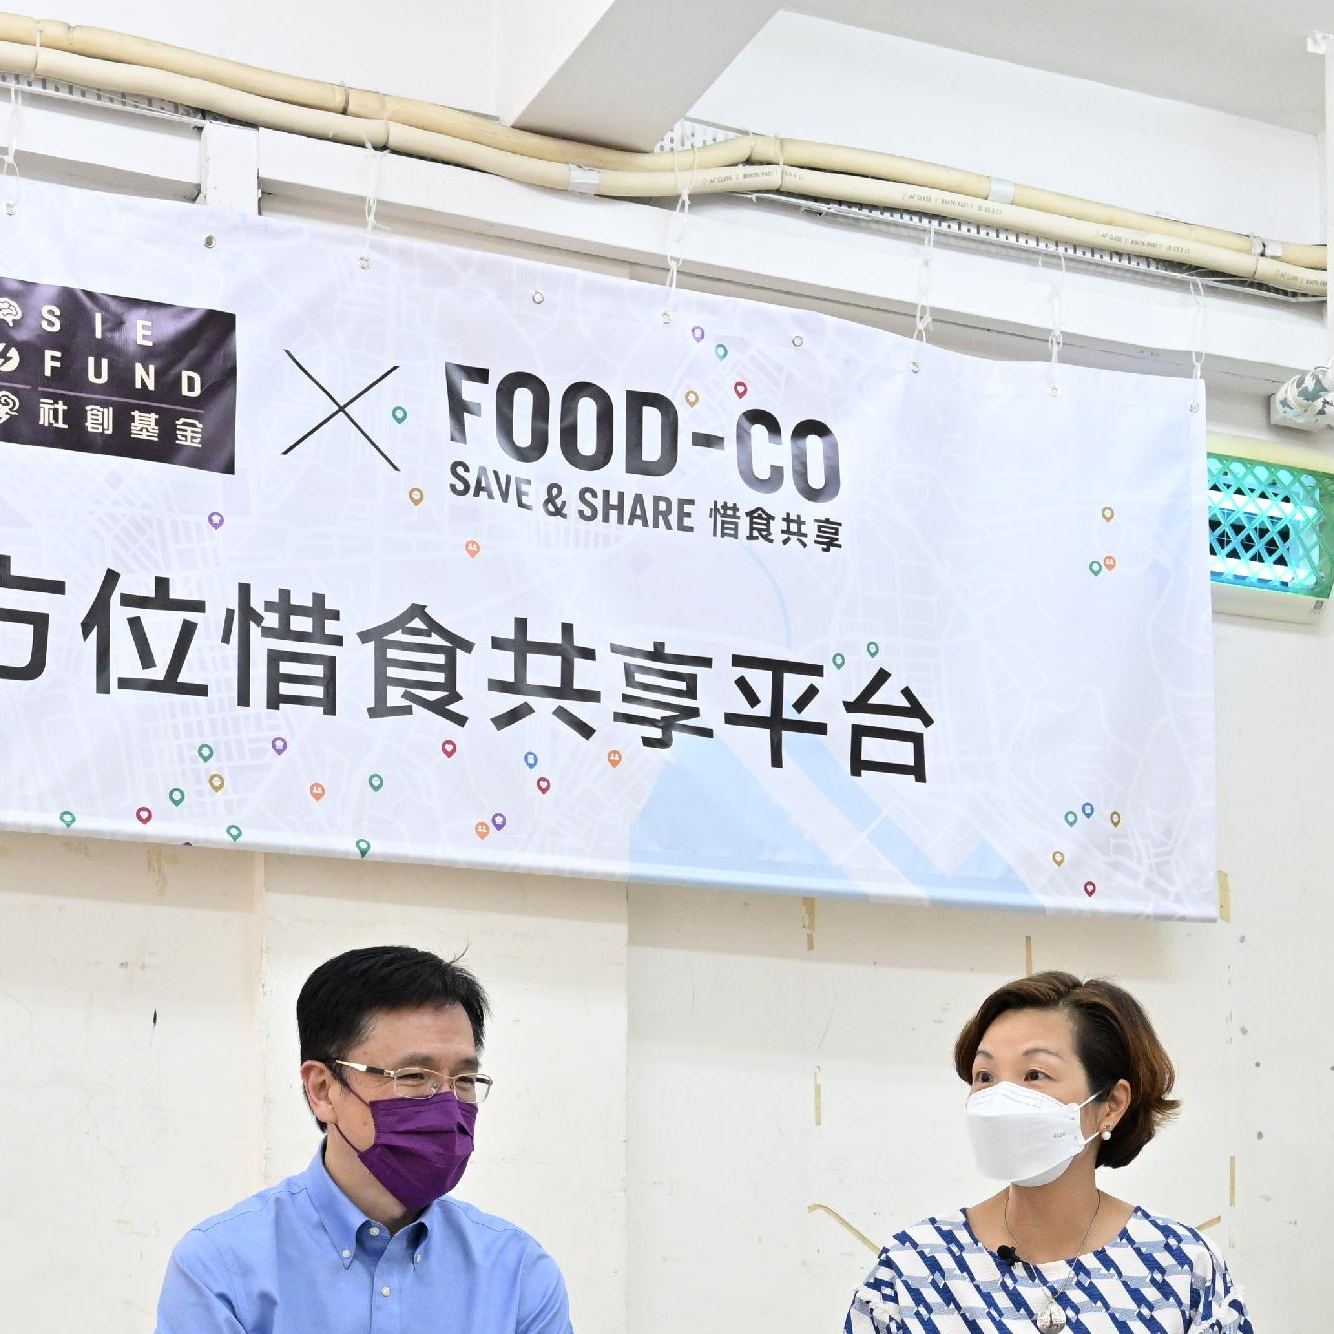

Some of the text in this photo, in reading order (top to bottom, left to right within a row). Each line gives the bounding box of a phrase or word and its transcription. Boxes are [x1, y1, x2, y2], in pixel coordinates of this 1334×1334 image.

[41, 305, 153, 347] SIE
[44, 350, 202, 398] FUND
[38, 399, 203, 448] 社創基金
[445, 361, 841, 504] FOOD-CO
[449, 460, 696, 533] SAVE & SHARE
[708, 500, 843, 553] 惜食共享
